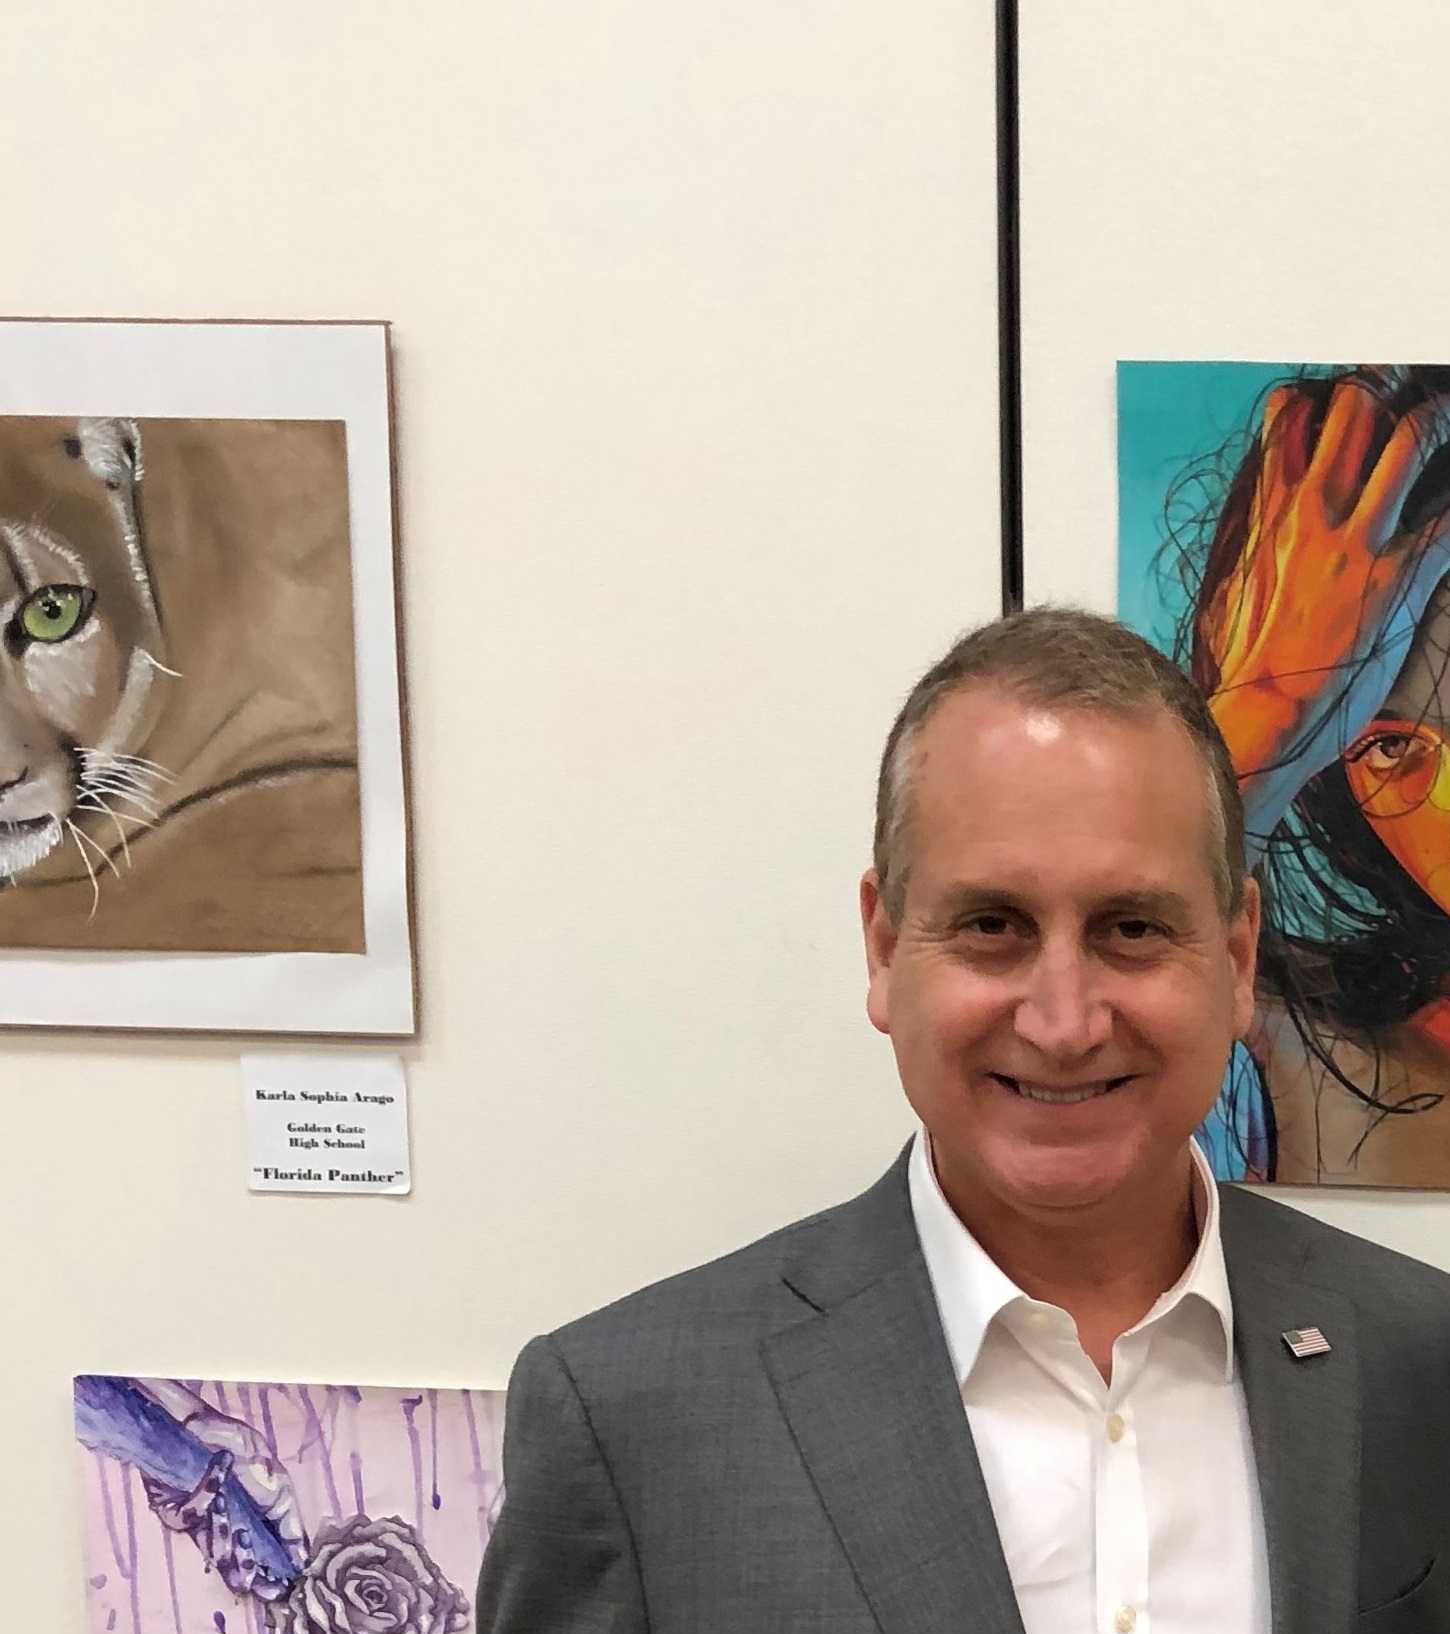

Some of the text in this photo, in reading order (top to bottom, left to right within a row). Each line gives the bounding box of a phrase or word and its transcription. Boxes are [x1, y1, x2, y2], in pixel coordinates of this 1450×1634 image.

[255, 1089, 395, 1105] Karla Sophia Arago
[287, 1122, 366, 1134] Golden Gate
[289, 1137, 366, 1150] High School
